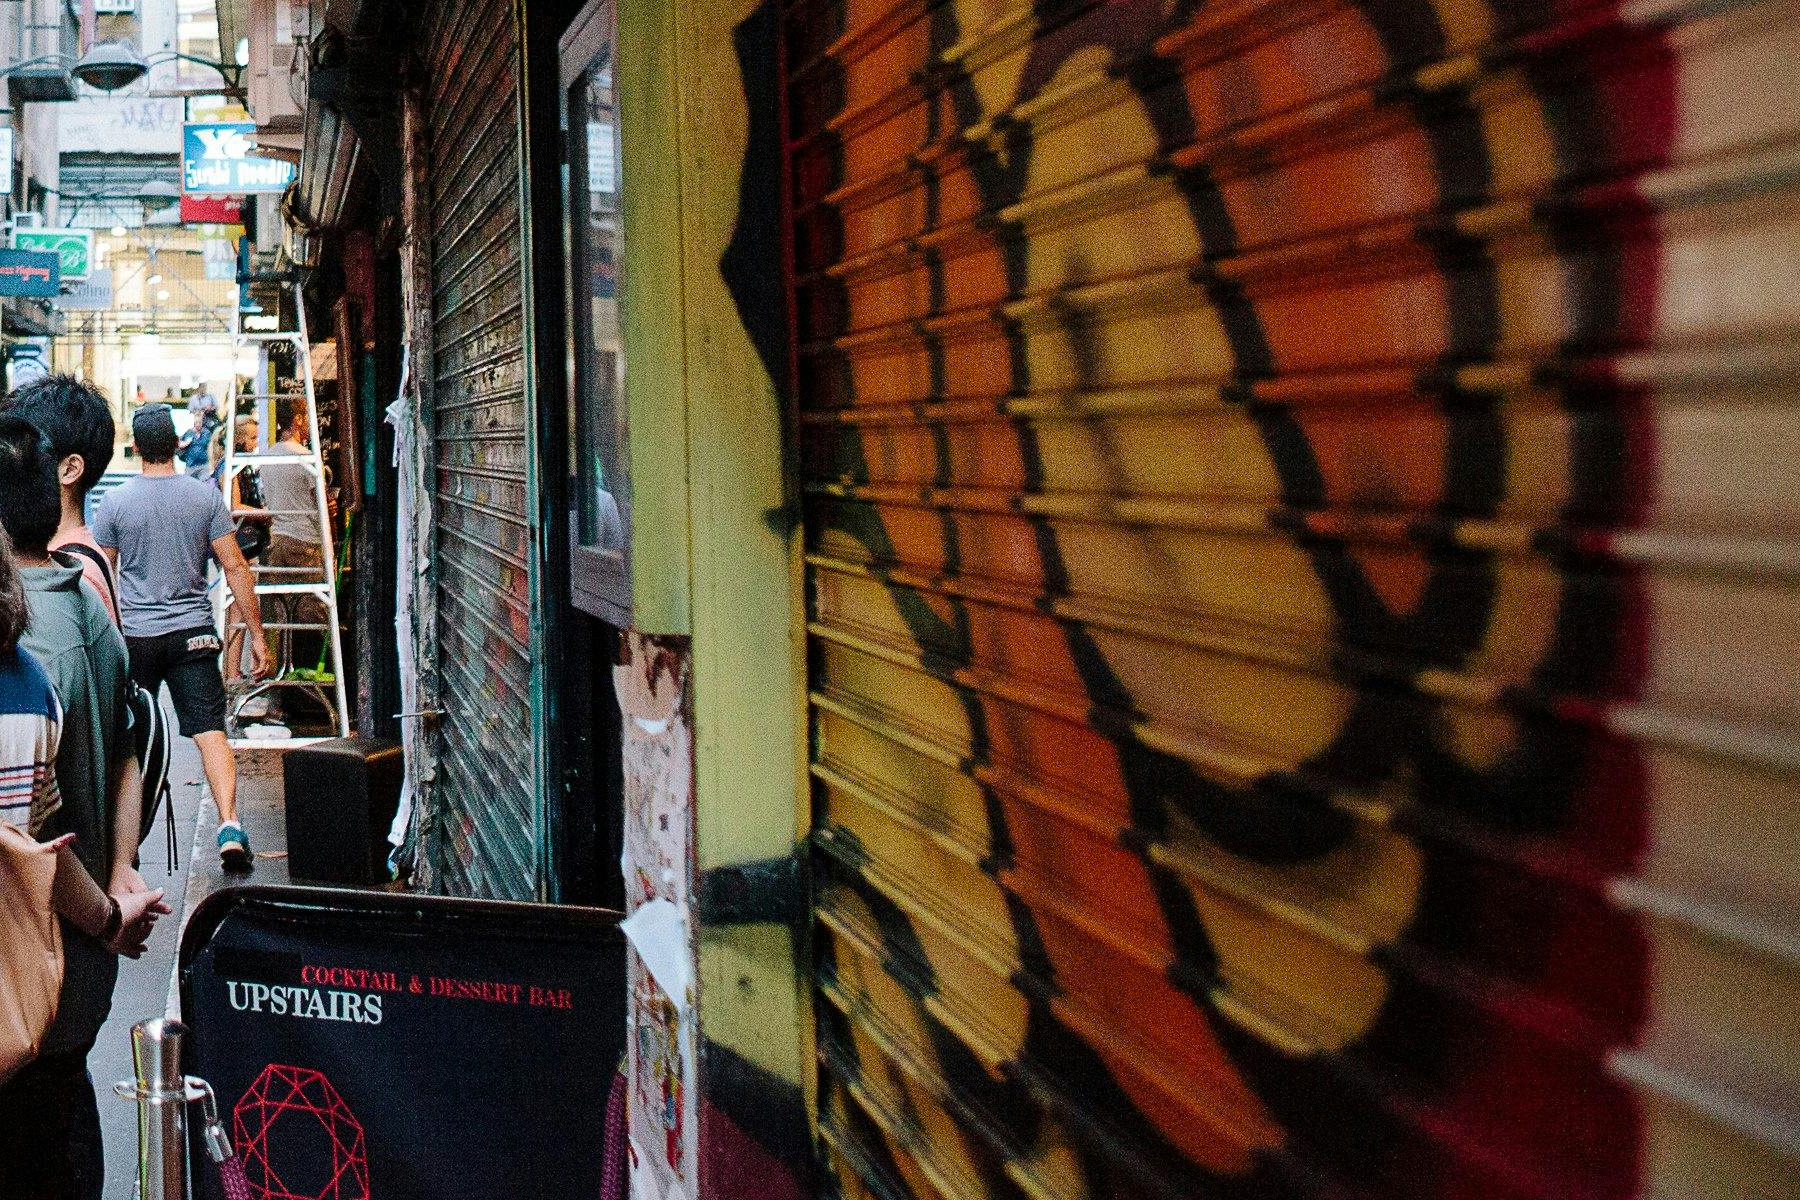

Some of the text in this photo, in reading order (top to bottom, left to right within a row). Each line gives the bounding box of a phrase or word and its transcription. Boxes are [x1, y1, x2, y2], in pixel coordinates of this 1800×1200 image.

[227, 981, 382, 1025] UPSTAIRS
[301, 964, 573, 1010] COCKTAIL & DESSERT BAR
